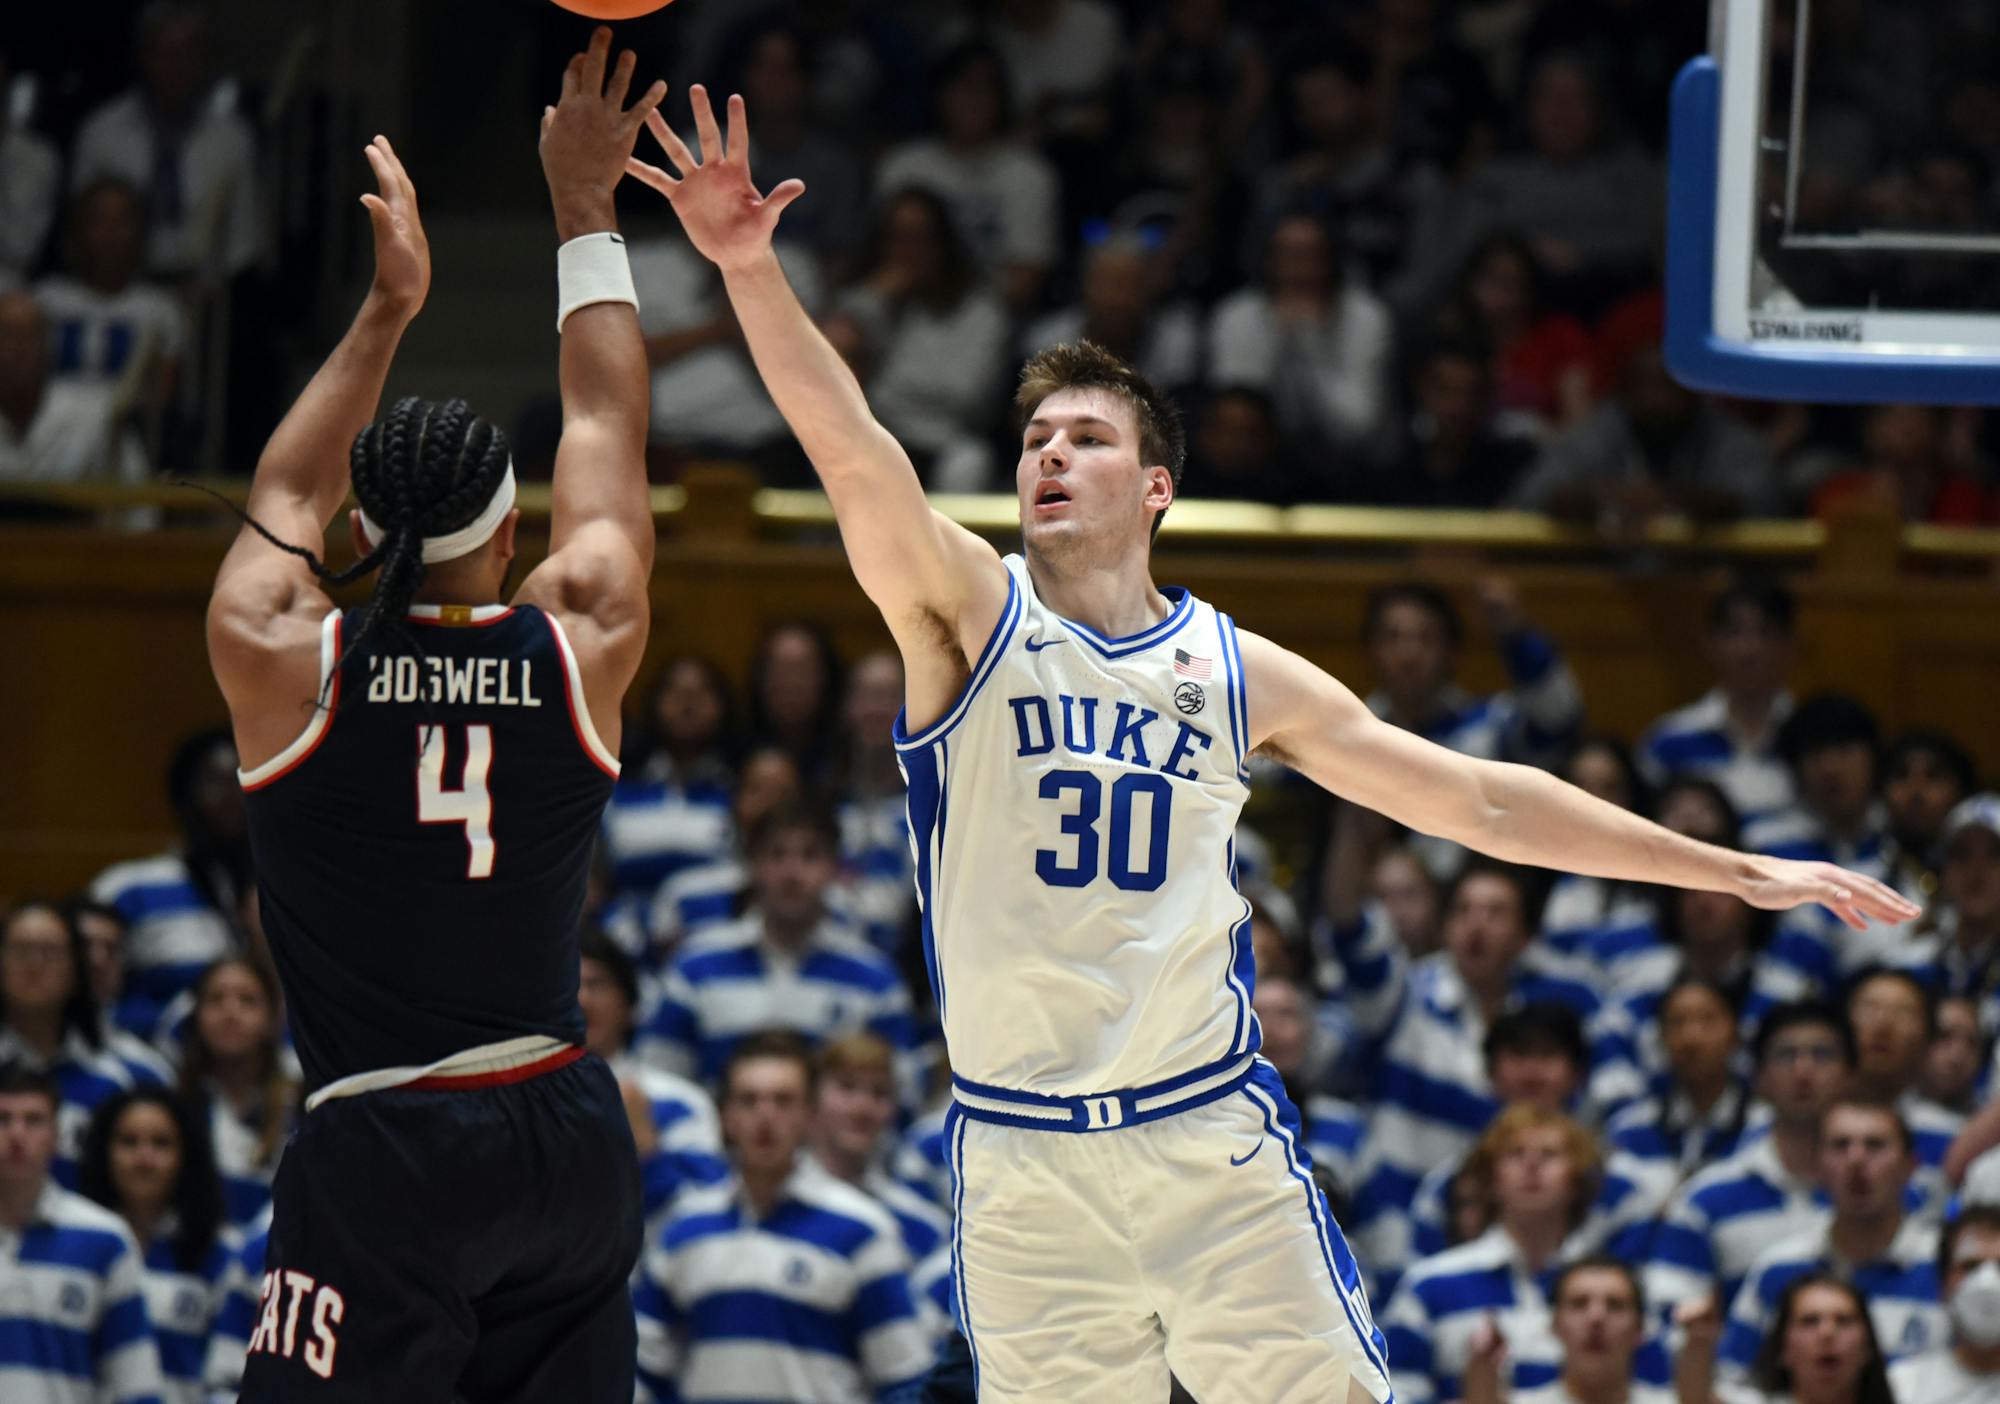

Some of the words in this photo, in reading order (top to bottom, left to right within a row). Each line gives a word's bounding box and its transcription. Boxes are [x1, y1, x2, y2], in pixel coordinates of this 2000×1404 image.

[1008, 694, 1212, 782] DUKE
[418, 724, 494, 879] 4
[1035, 769, 1173, 892] 30
